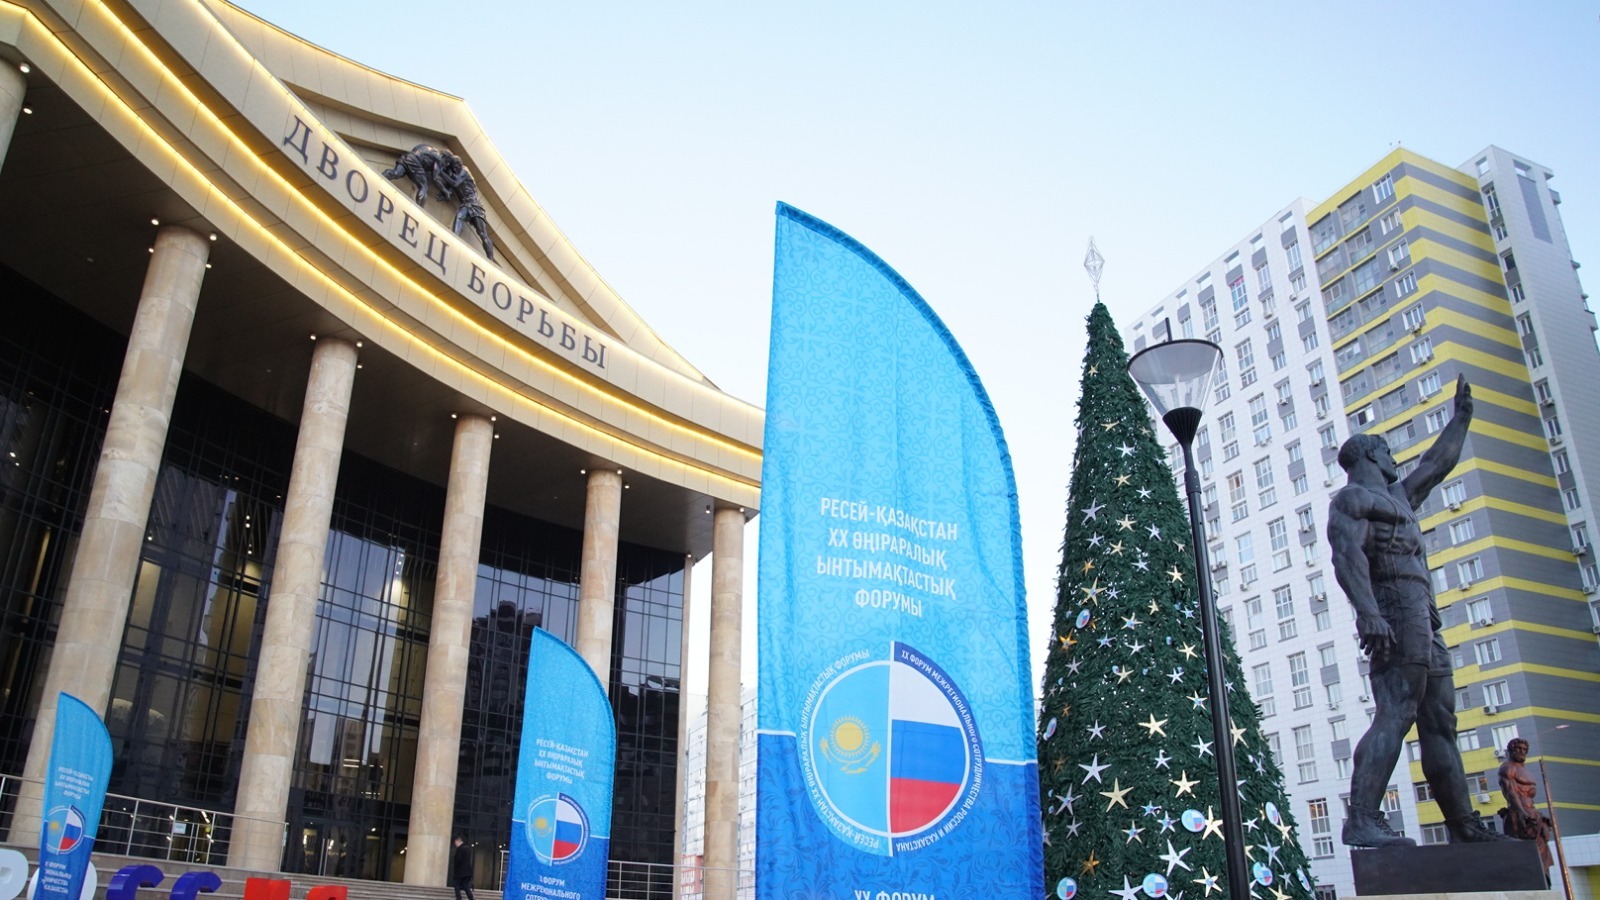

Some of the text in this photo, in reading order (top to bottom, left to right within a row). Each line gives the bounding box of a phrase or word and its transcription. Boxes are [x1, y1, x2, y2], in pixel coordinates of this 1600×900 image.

[283, 114, 608, 370] ДВОРЕЦ БОРЬБЫ
[820, 497, 958, 541] РЕСЕЙ-ҚАЗАҚСТАН
[852, 531, 947, 571] ӨҢІРАРАЛЫҚ
[816, 555, 957, 600] ЫНТЫМАҚТАСТЫҚ
[855, 588, 922, 618] ФОРУМЫ
[910, 654, 932, 674] ФОРУМ
[942, 808, 968, 834] РОССИИ
